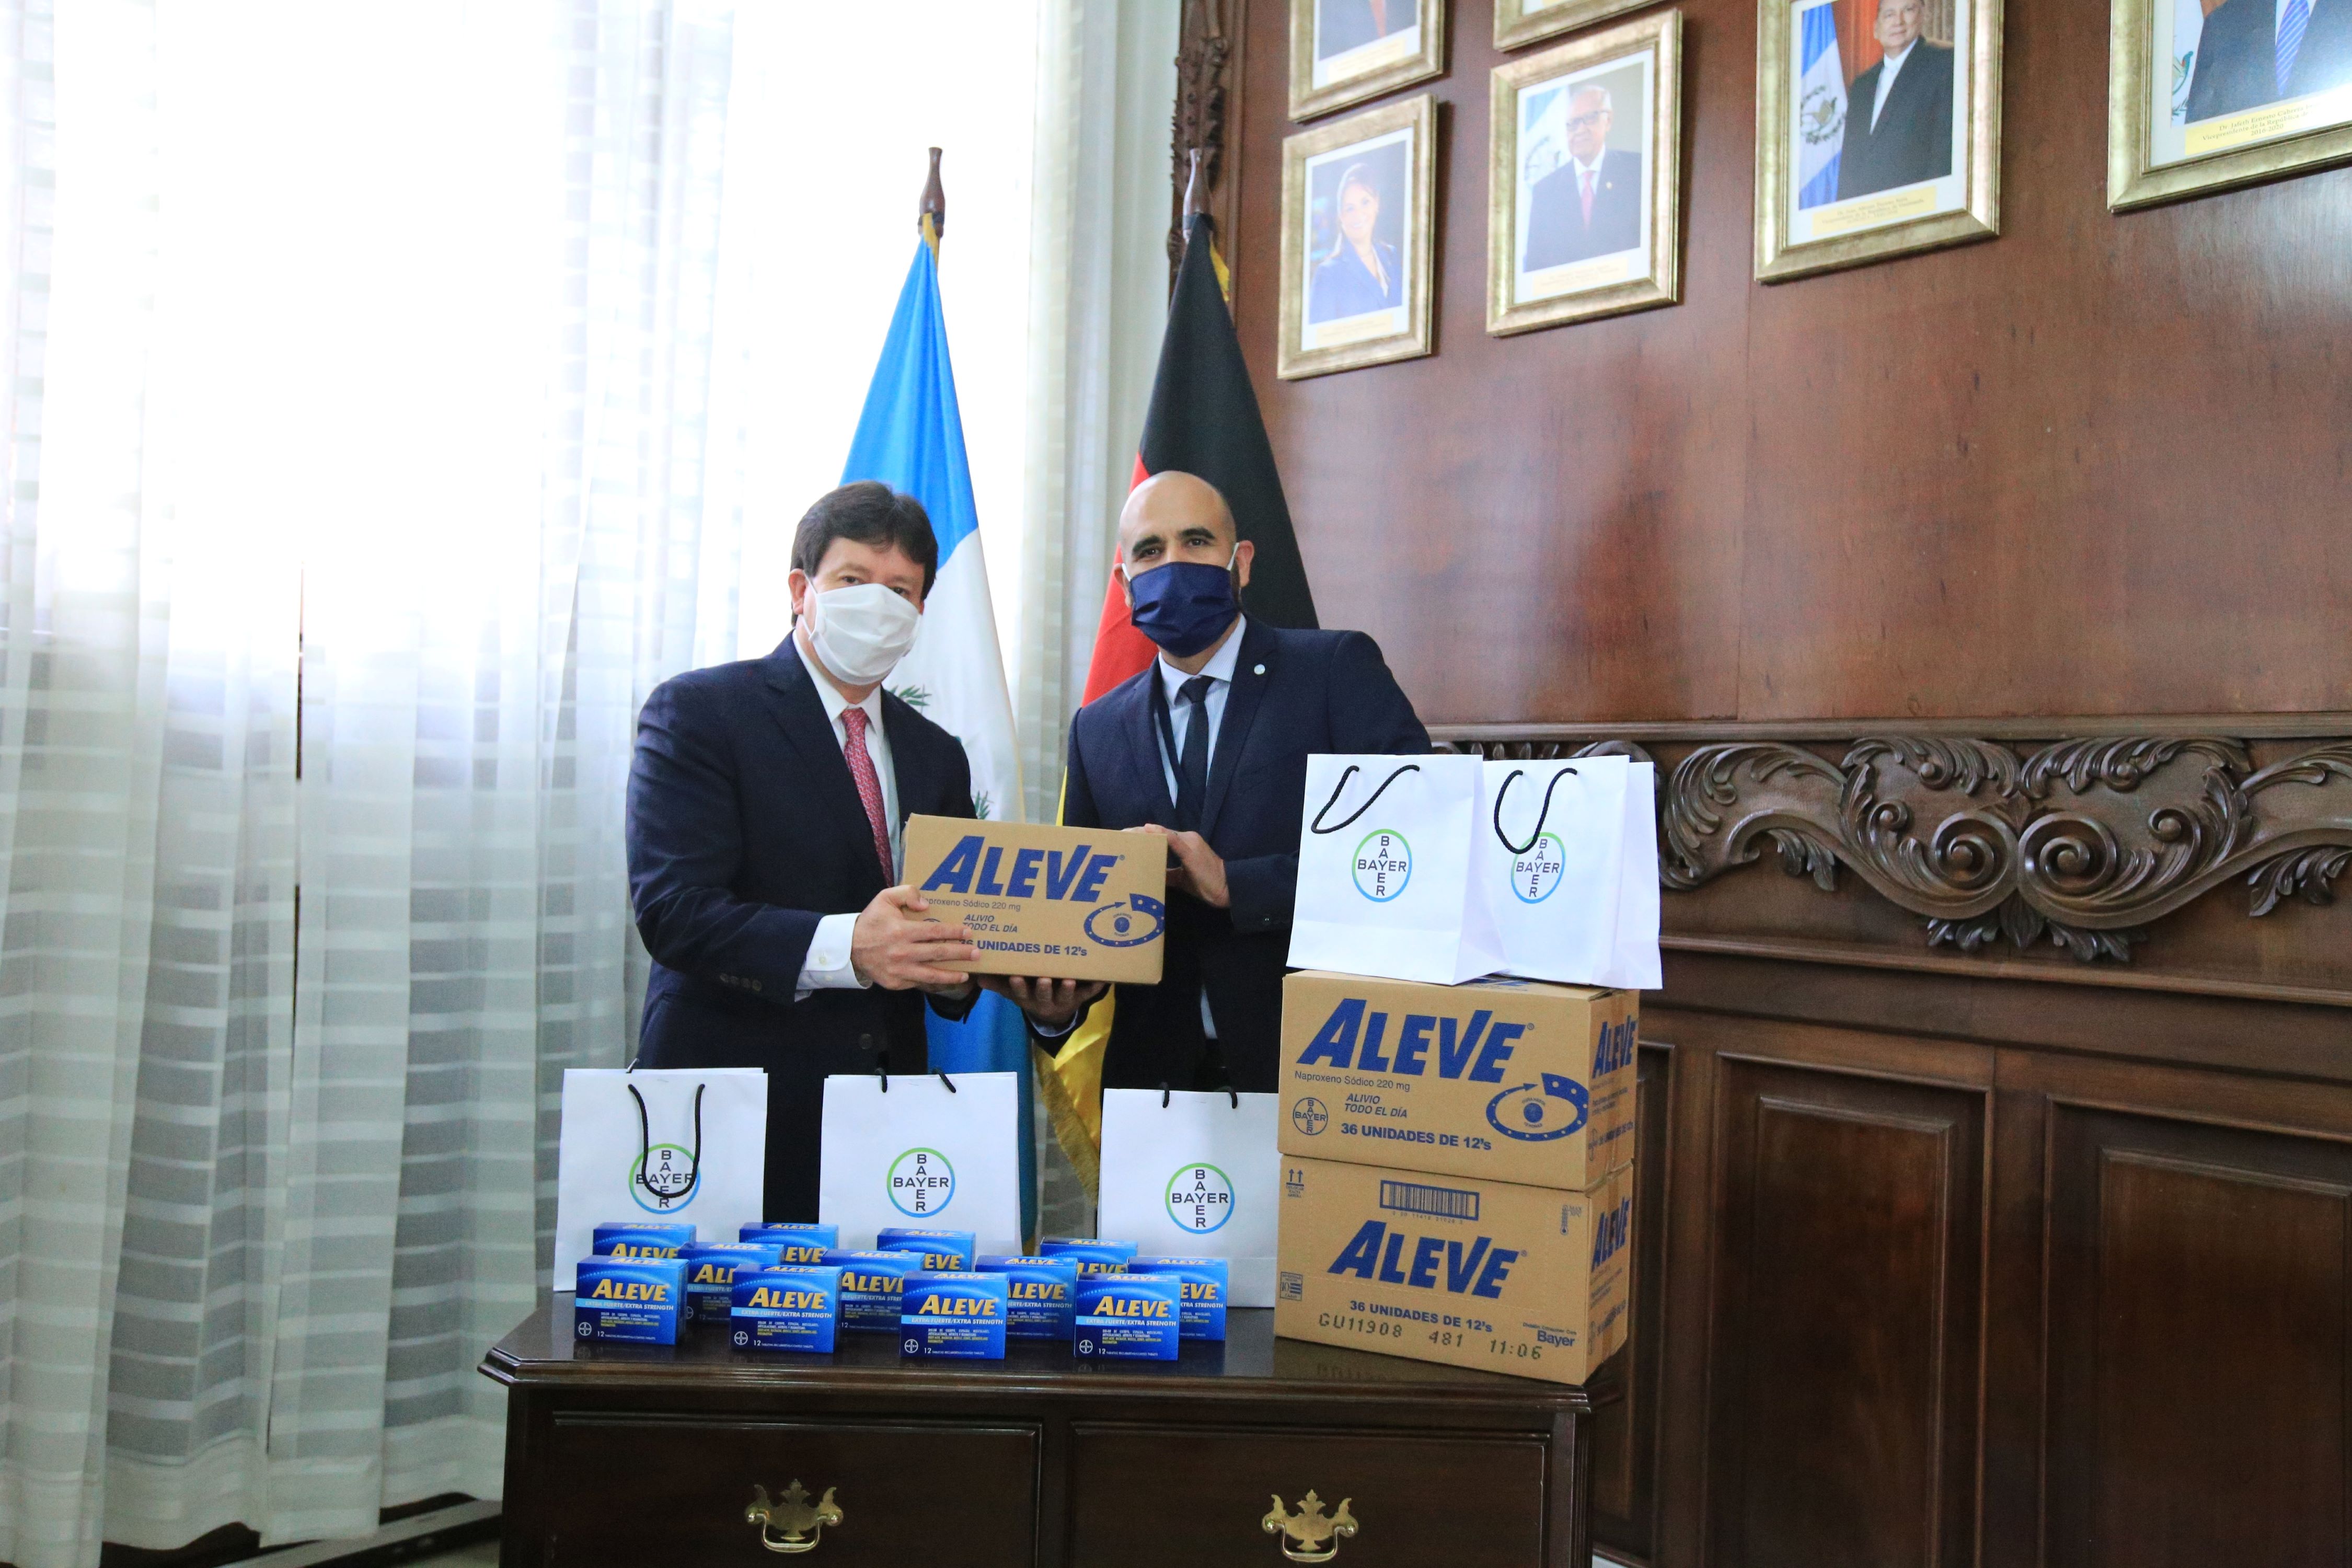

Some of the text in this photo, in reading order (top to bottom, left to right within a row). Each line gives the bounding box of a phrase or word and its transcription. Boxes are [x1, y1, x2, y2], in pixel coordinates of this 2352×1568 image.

[2202, 126, 2249, 141] Vicepresidente
[2267, 113, 2299, 125] República
[2231, 118, 2250, 129] Jafeth
[2251, 113, 2276, 124] Ernesto
[2277, 106, 2304, 117] Cabrera
[2251, 123, 2284, 136] 2016-2020
[1357, 859, 1406, 872] BAYER
[1376, 835, 1390, 896] BAYER
[1516, 861, 1560, 874] BAYER
[925, 897, 961, 907] proxeno
[963, 900, 989, 908] Sódico
[1002, 924, 1018, 933] DÍA
[977, 940, 1041, 954] UNIDADES
[1044, 945, 1060, 955] DE
[1295, 1070, 1410, 1092] Naproxeno Sódico 220 mg
[1346, 1093, 1380, 1104] ALIVIO
[1295, 1112, 1327, 1122] BAYER
[1344, 1103, 1408, 1119] TODO EL DÍA
[1341, 1123, 1492, 1150] 36 UNIDADES DE 12's
[893, 1177, 949, 1187] BAYER
[916, 1154, 927, 1212] BAYER
[1172, 1193, 1229, 1204] BAYER
[1194, 1169, 1206, 1228] BAYER
[592, 1278, 668, 1302] ALEVE
[748, 1287, 825, 1309] ALEVE
[918, 1294, 998, 1316] ALEVE
[1093, 1295, 1170, 1318] ALEVE
[1350, 1300, 1493, 1332] 36 UNIDADES DE 12's
[1319, 1313, 1542, 1359] GU11908 481 11:06
[1537, 1330, 1575, 1347] Bayer
